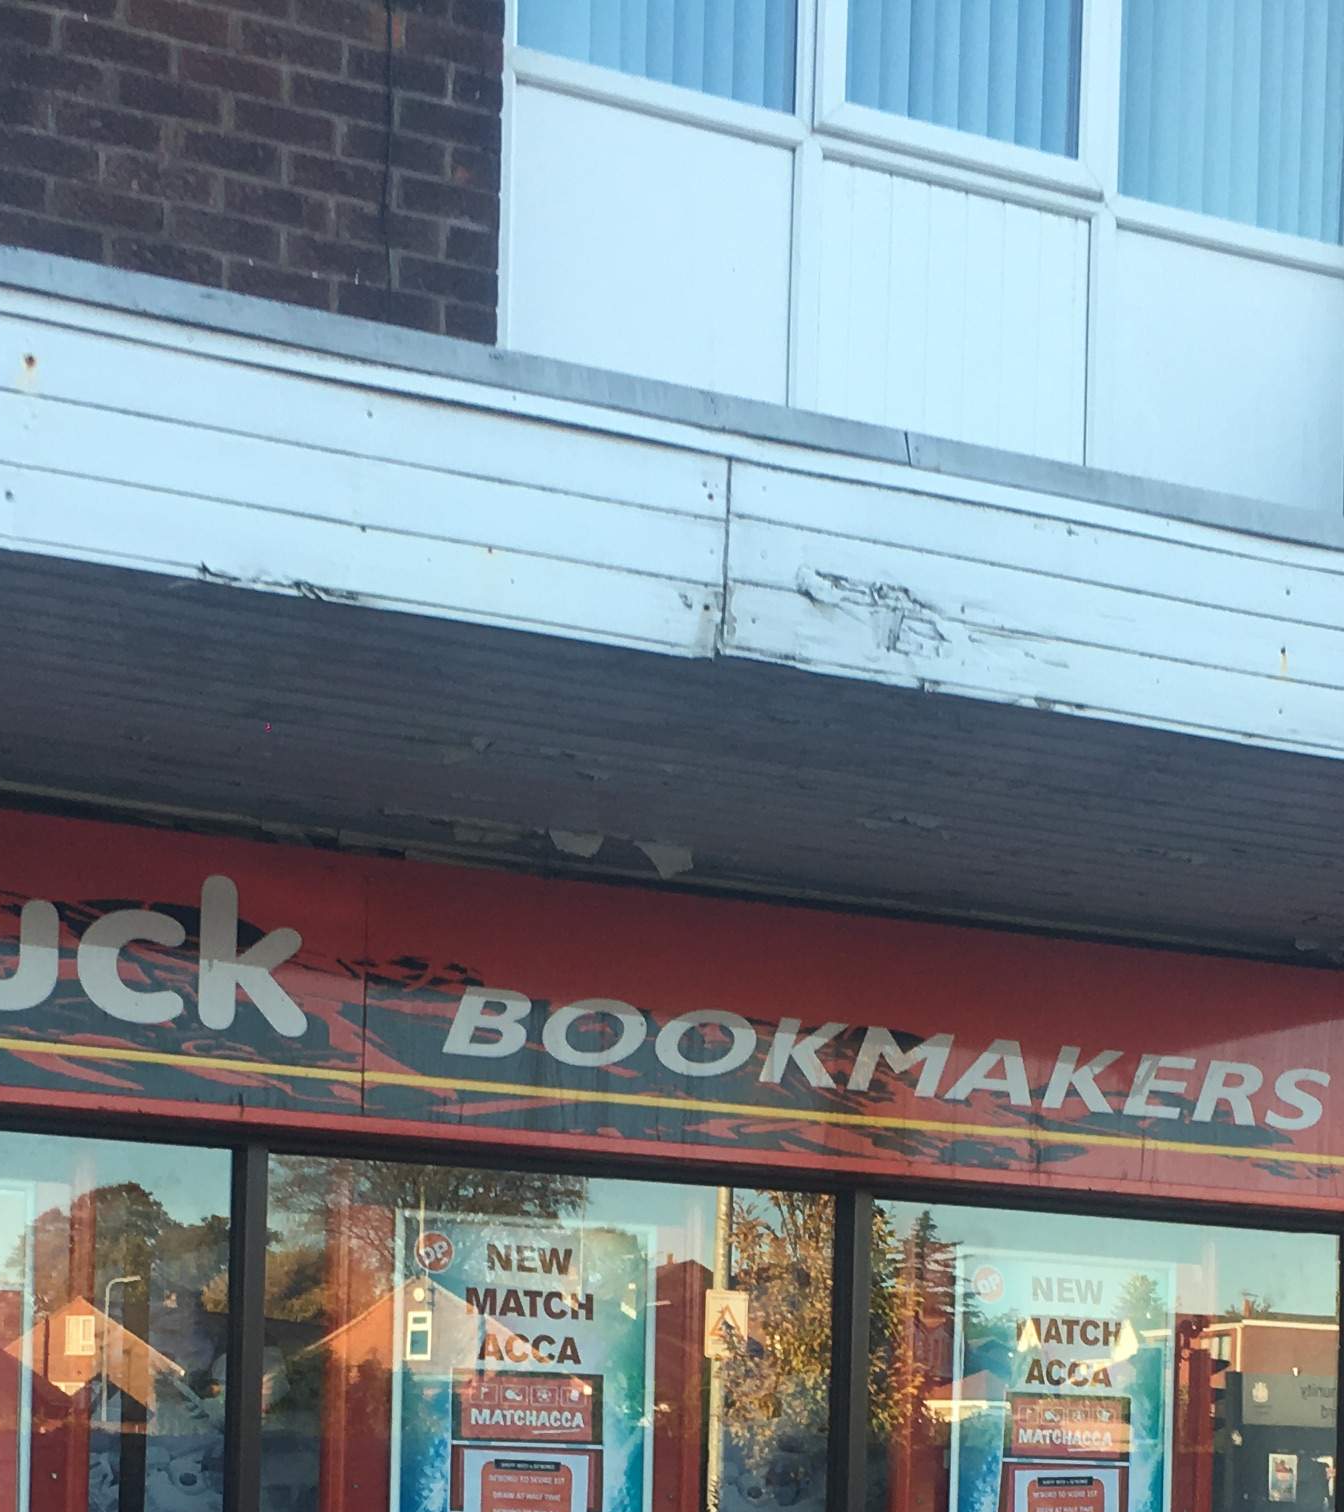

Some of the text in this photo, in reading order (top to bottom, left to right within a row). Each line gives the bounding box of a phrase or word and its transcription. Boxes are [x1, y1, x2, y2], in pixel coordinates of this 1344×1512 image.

[442, 986, 1333, 1134] BOOKMAKERS
[486, 1243, 573, 1276] NEW
[465, 1286, 594, 1321] MATCH
[1031, 1276, 1104, 1304] NEW
[478, 1334, 582, 1365] ACCA
[1025, 1359, 1112, 1388] ACCA
[470, 1408, 585, 1428] MATCHACCA
[1018, 1428, 1113, 1446] MATCHACCA
